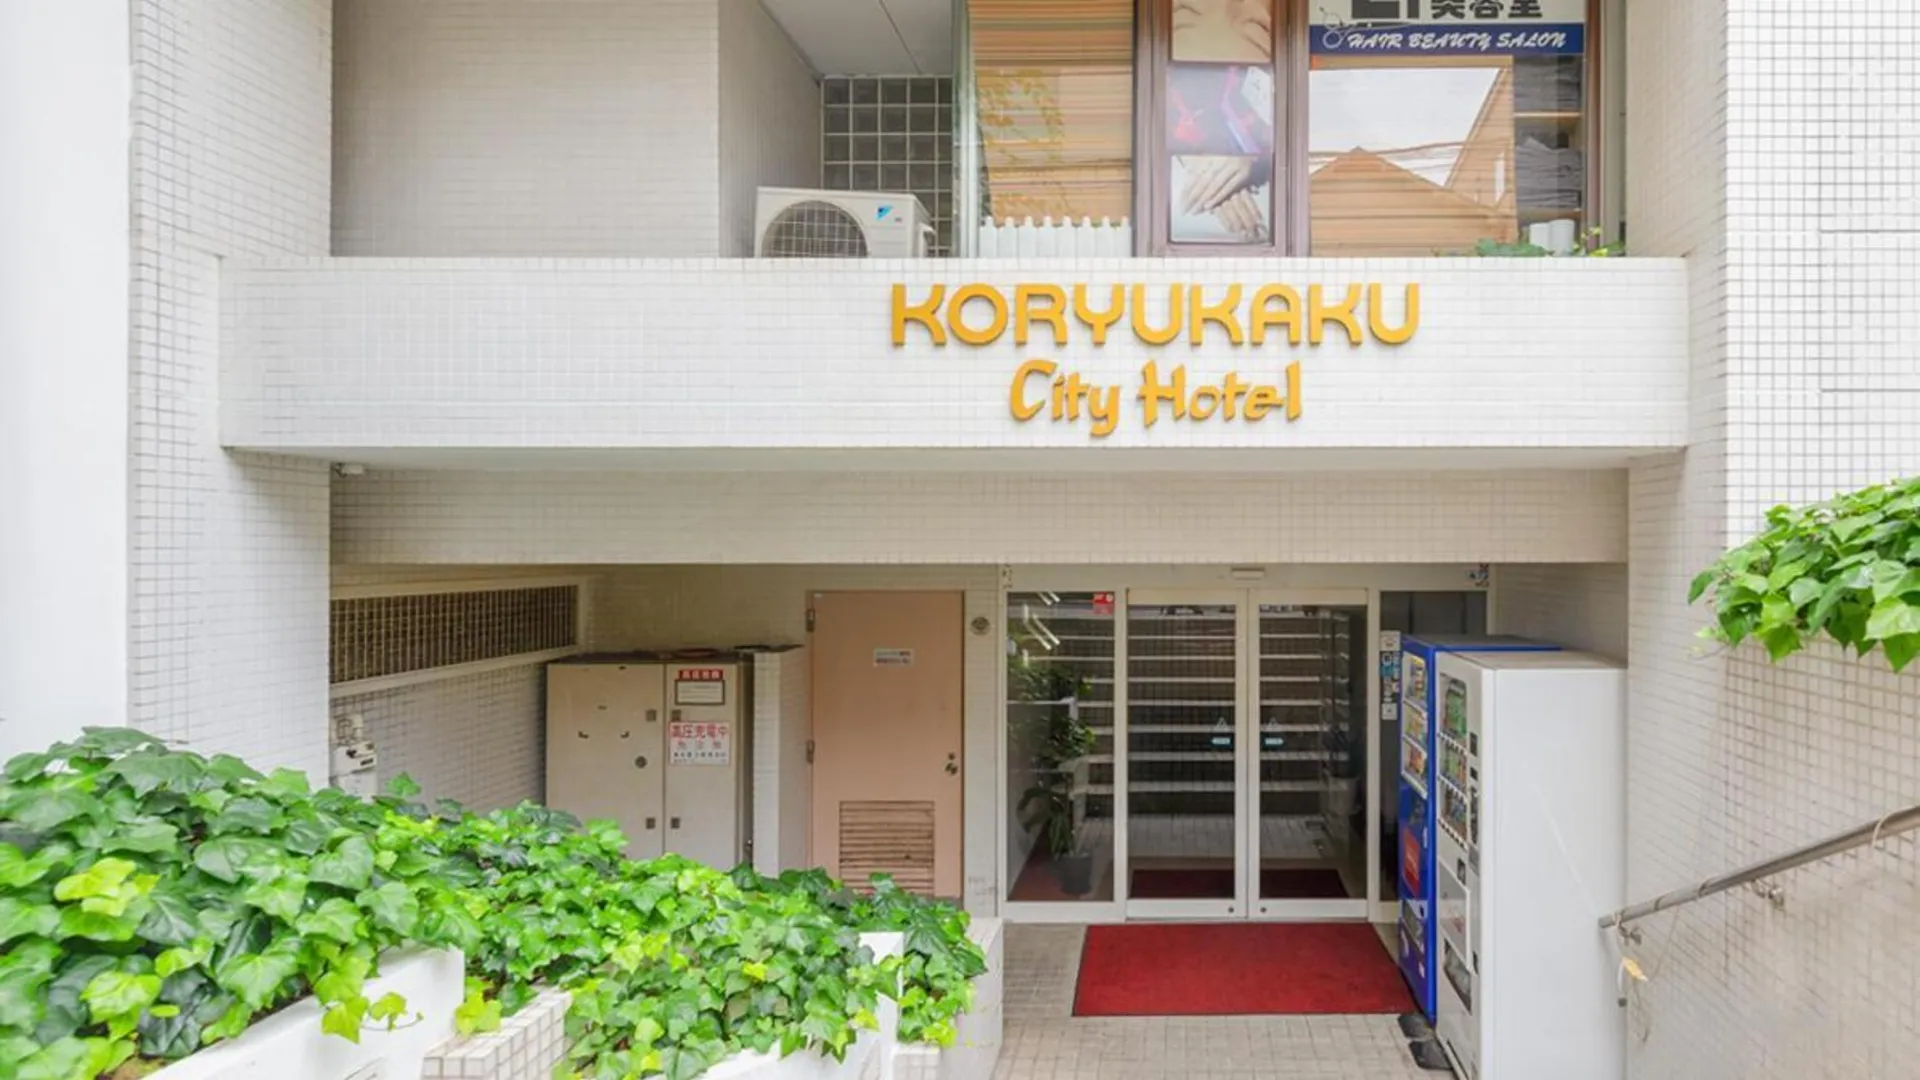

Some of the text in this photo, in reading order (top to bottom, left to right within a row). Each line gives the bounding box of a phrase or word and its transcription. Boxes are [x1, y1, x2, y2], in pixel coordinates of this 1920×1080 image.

[1347, 32, 1567, 51] HAIR BEAUTY SALON
[891, 283, 1420, 346] KORYUKAKU
[1010, 359, 1303, 437] City Hotel
